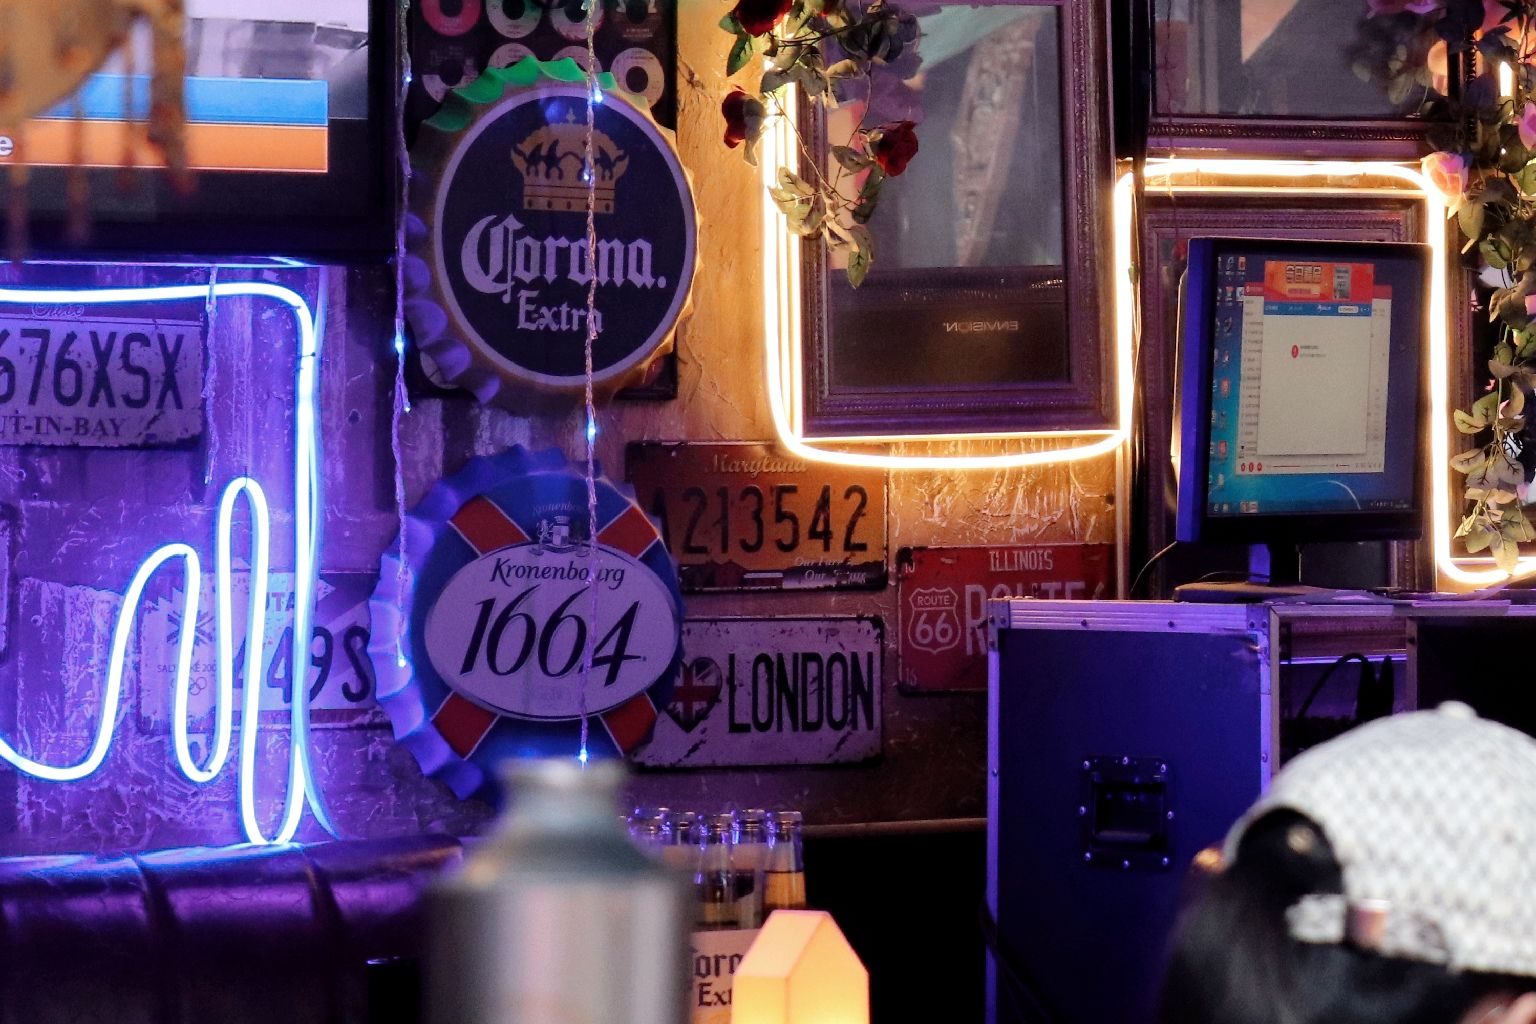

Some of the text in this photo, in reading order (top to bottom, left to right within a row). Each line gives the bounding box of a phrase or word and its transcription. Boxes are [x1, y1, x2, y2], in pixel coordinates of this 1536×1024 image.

[704, 453, 808, 477] Maryland
[989, 550, 1053, 572] ILLINOIS
[917, 595, 951, 606] ROUTE
[459, 583, 642, 687] 1664
[915, 611, 953, 645] 66
[728, 651, 874, 734] LONDON
